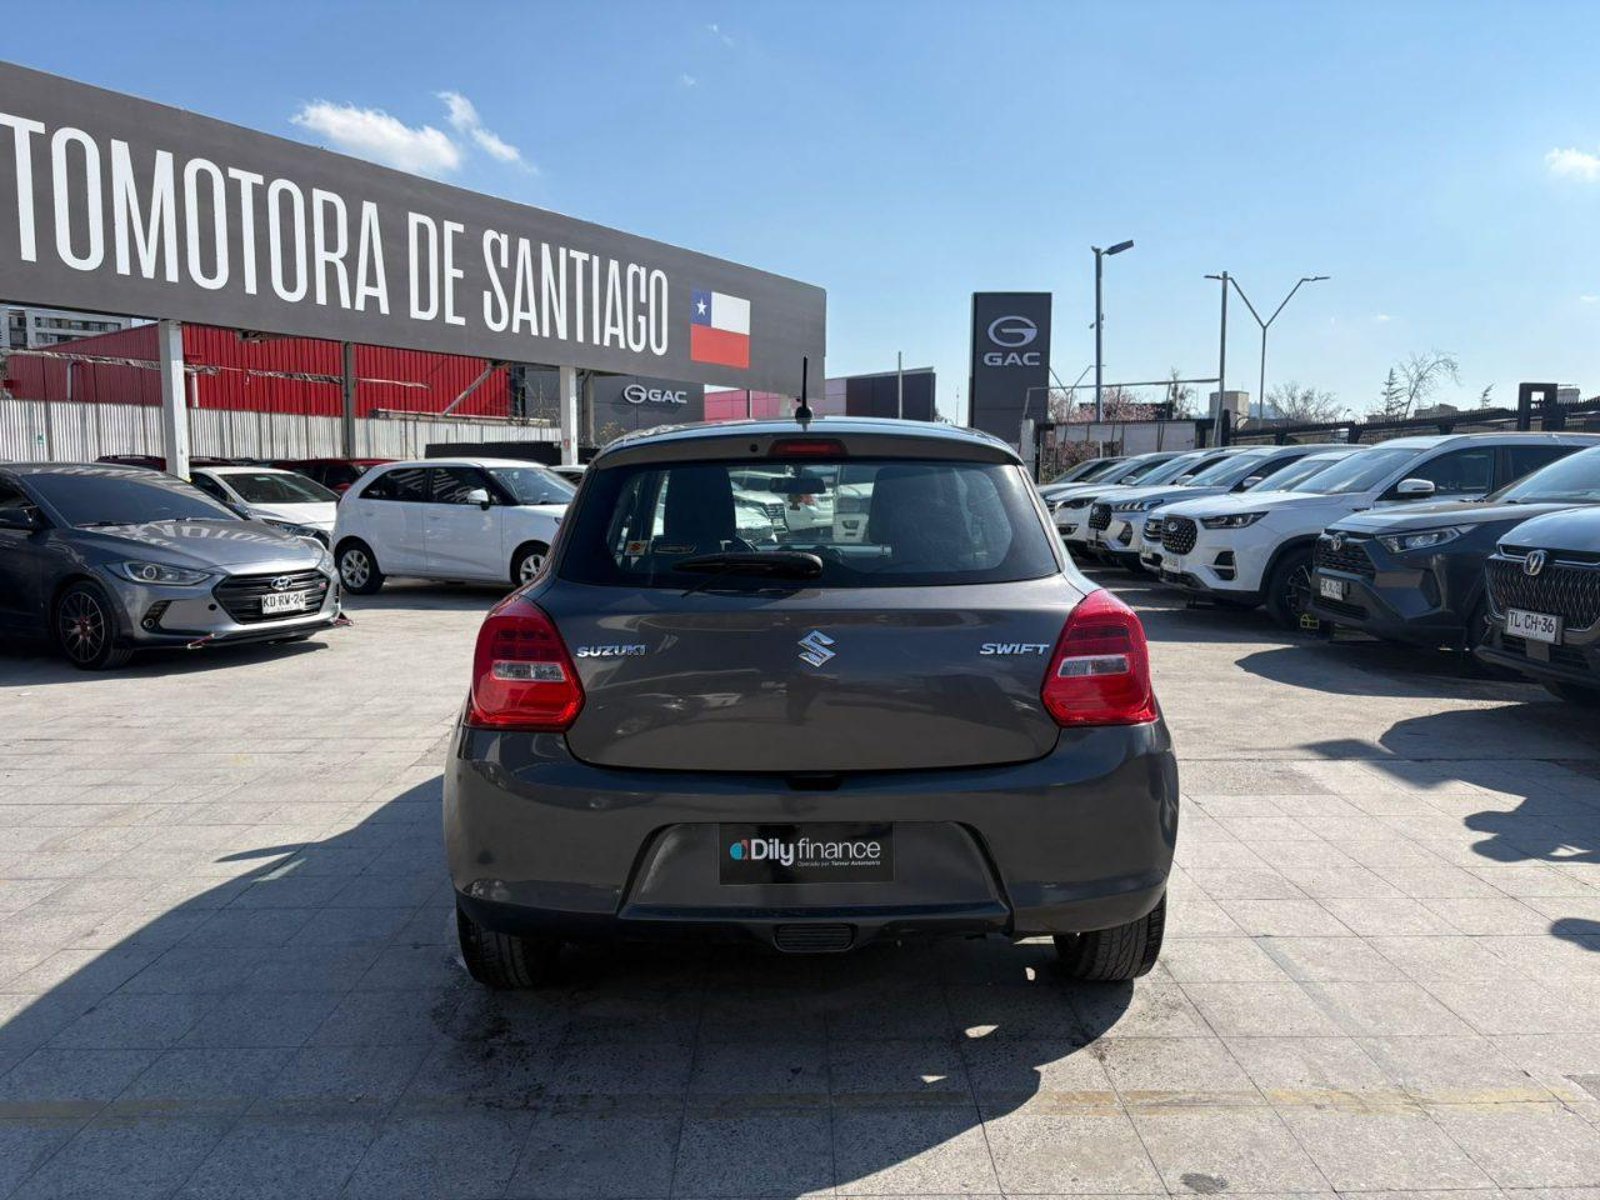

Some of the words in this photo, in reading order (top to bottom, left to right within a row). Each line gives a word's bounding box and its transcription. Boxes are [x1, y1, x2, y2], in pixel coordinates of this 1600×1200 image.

[0, 112, 390, 315] TOMOTORA
[408, 211, 466, 326] DE
[482, 229, 669, 356] SANTIAGO
[983, 352, 1041, 366] GAC
[648, 389, 687, 404] GAC
[1509, 611, 1521, 628] TL
[1524, 614, 1555, 634] CH-36
[576, 644, 647, 658] SUZUKI
[979, 643, 1051, 655] SWIFT
[750, 838, 795, 867] Dily
[797, 838, 881, 860] finance
